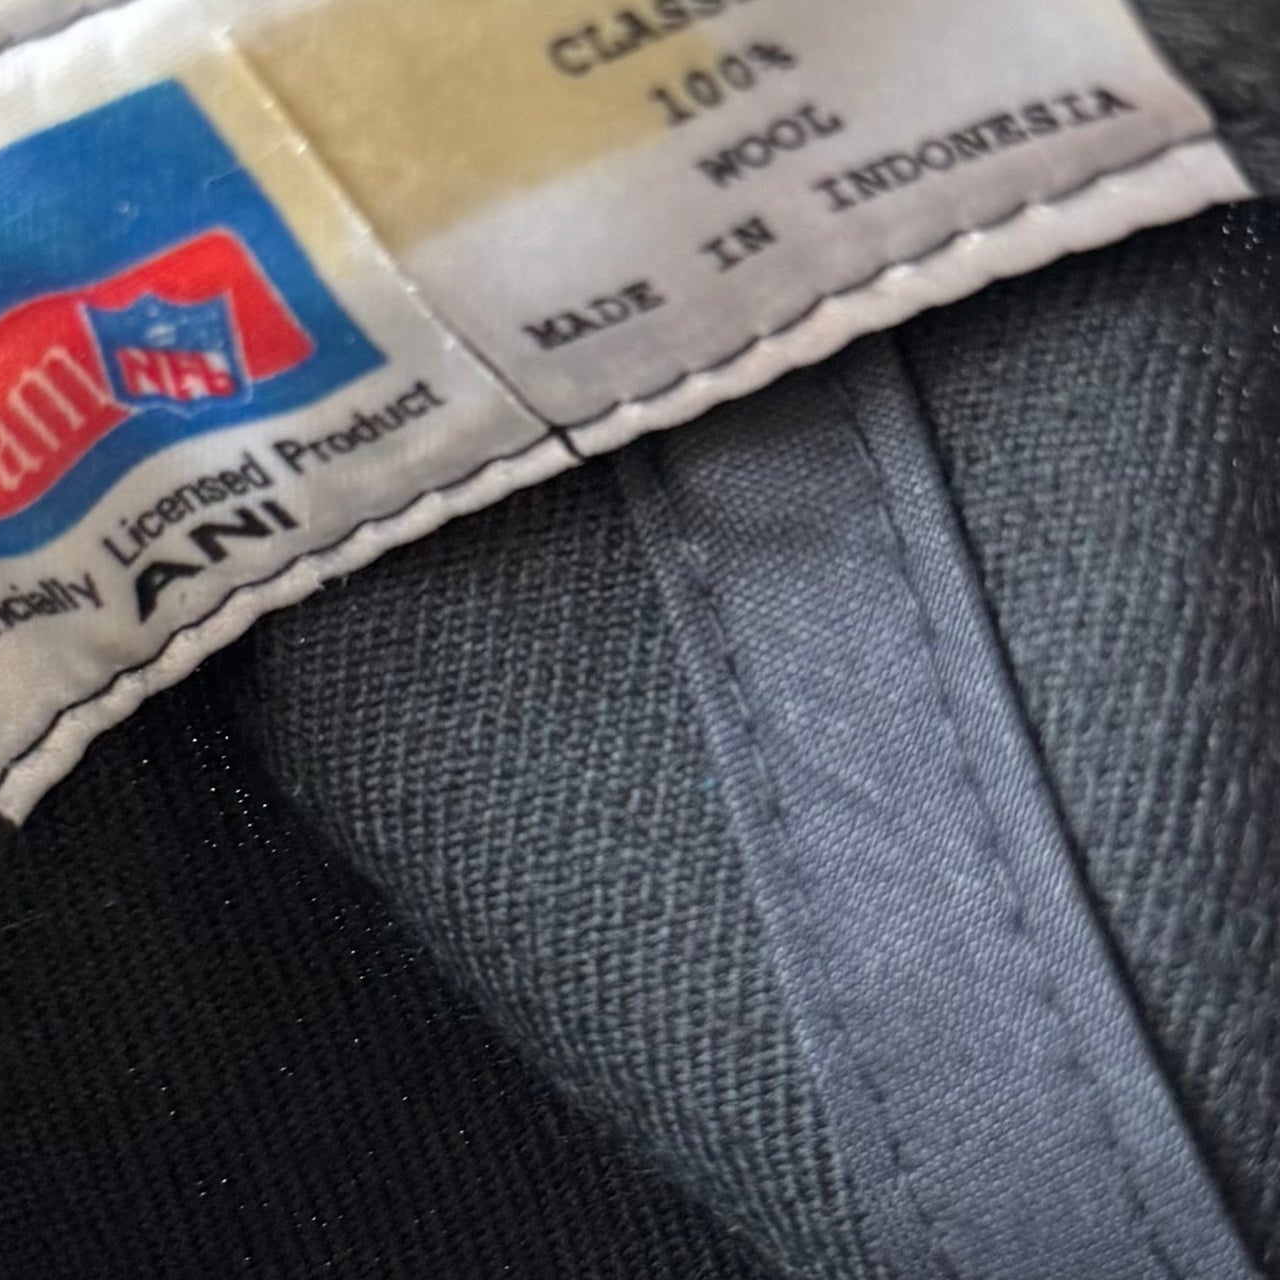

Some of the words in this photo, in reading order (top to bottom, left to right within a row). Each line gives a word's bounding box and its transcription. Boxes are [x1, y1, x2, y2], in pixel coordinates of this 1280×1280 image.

[647, 41, 796, 128] 100%
[696, 103, 845, 187] WOOL
[521, 278, 665, 352] MADE
[698, 216, 778, 272] IN
[812, 86, 1137, 212] INDONESIA
[116, 344, 236, 403] NFL
[101, 453, 273, 566] Licensed
[273, 377, 447, 476] Product
[135, 498, 302, 623] ANI
